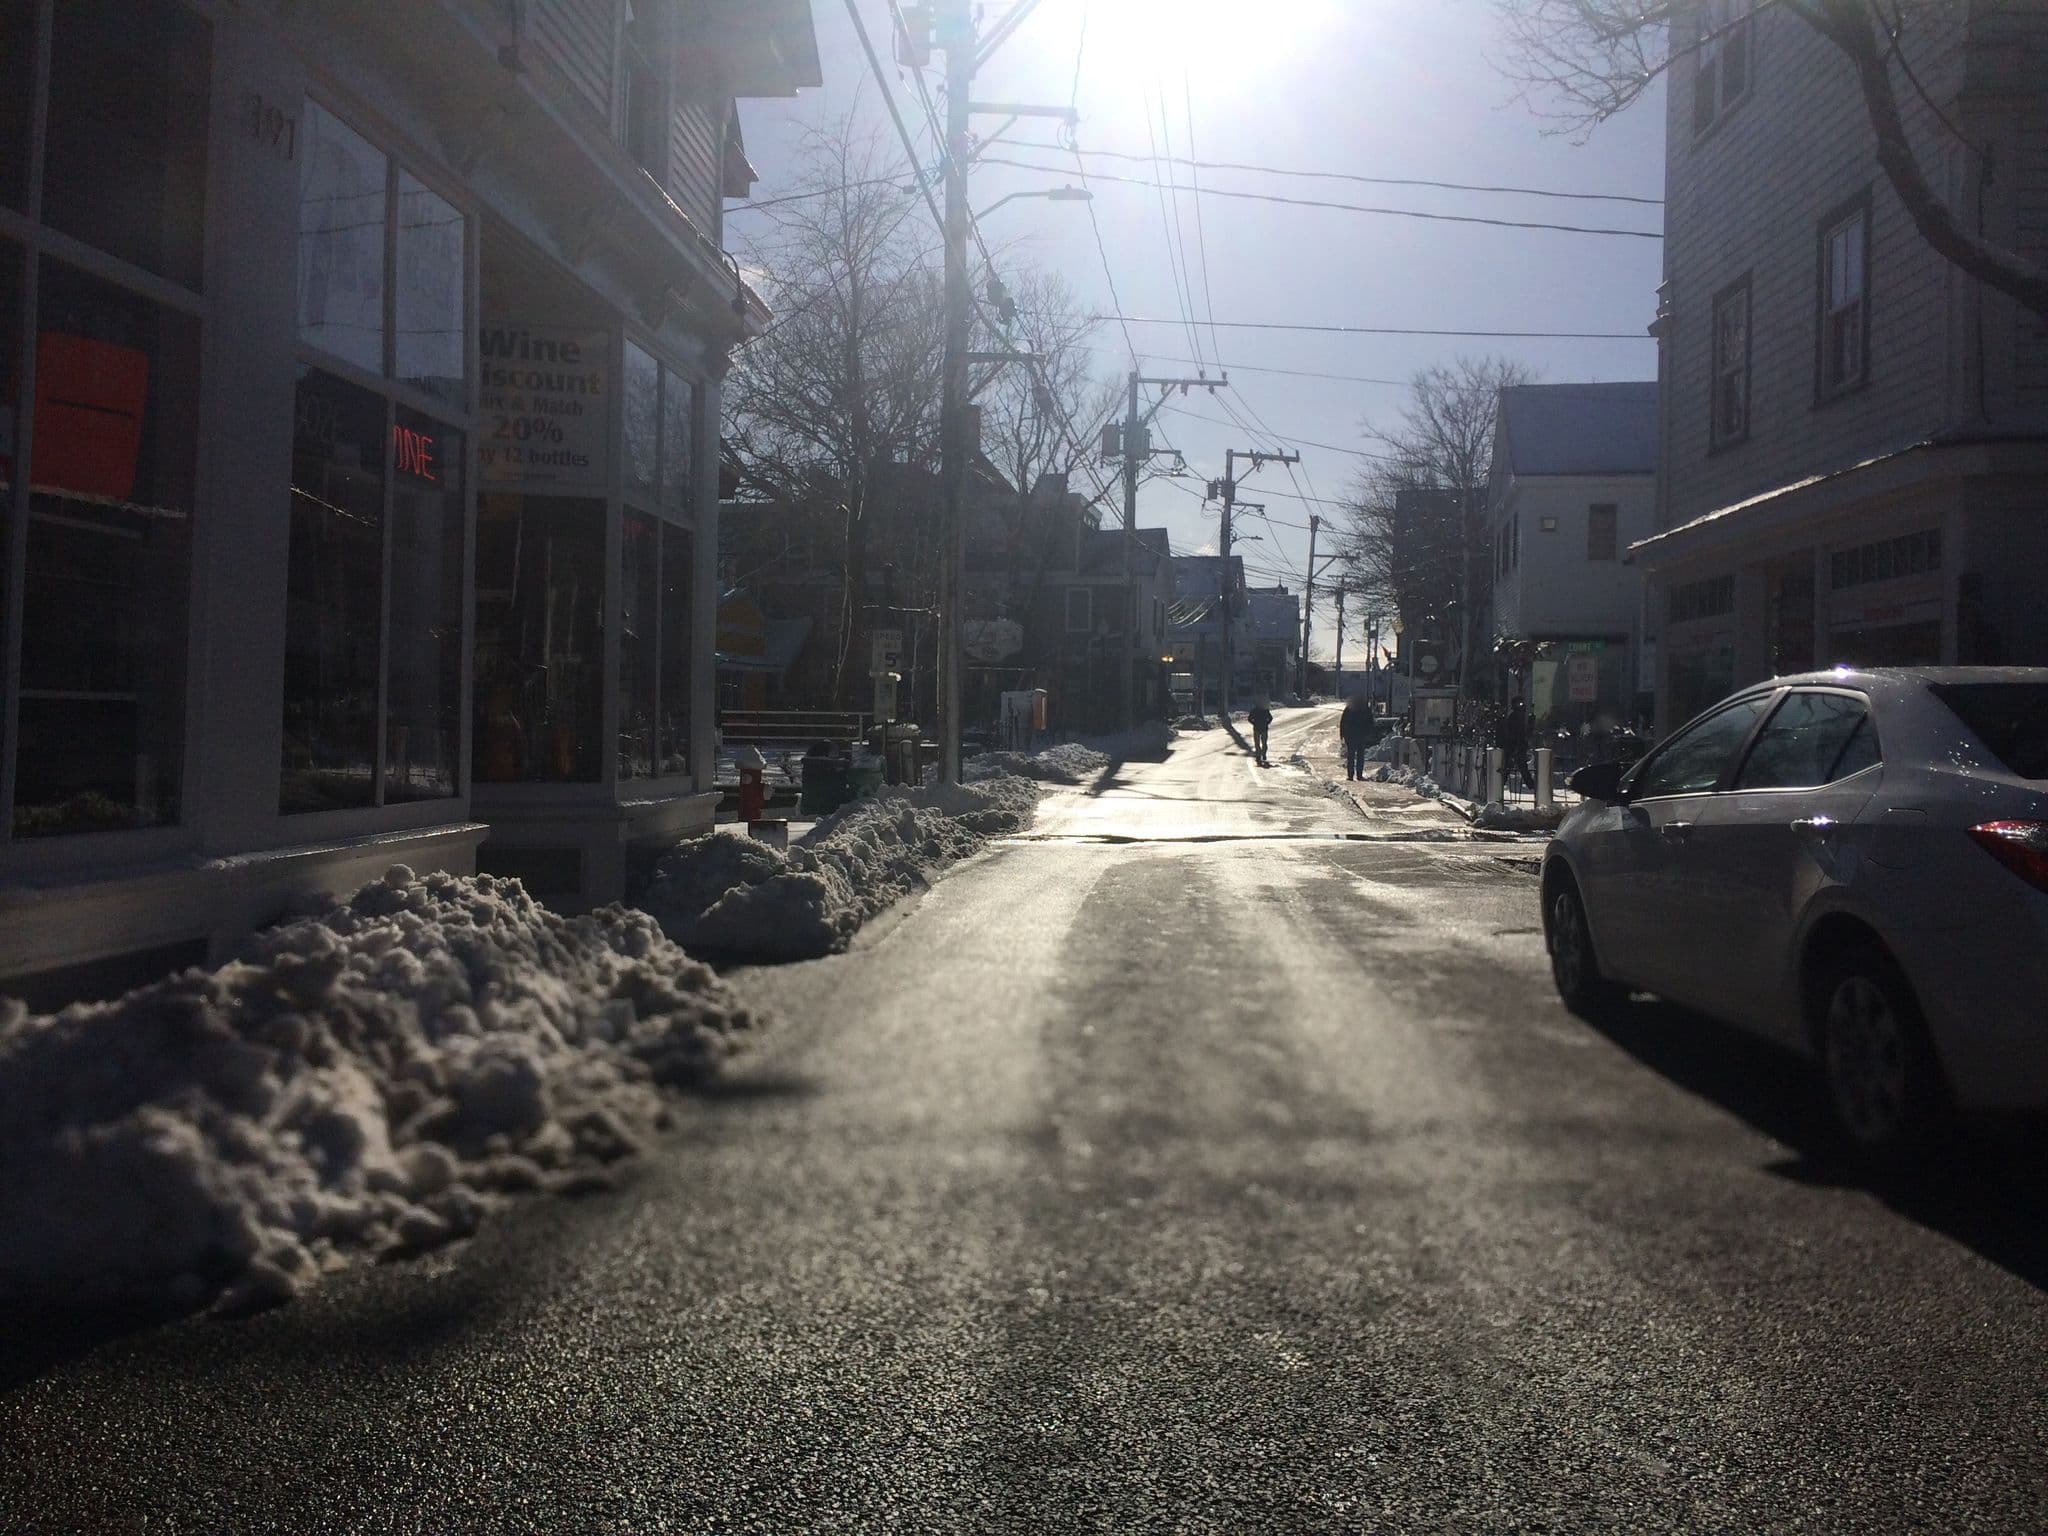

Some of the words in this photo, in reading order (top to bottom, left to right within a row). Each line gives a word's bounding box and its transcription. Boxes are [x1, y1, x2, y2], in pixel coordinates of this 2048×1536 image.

[479, 327, 581, 364] Wine
[480, 363, 601, 395] iscount
[533, 396, 584, 416] Match
[491, 415, 564, 443] 20%
[392, 424, 437, 480] INE
[527, 448, 590, 467] bottles
